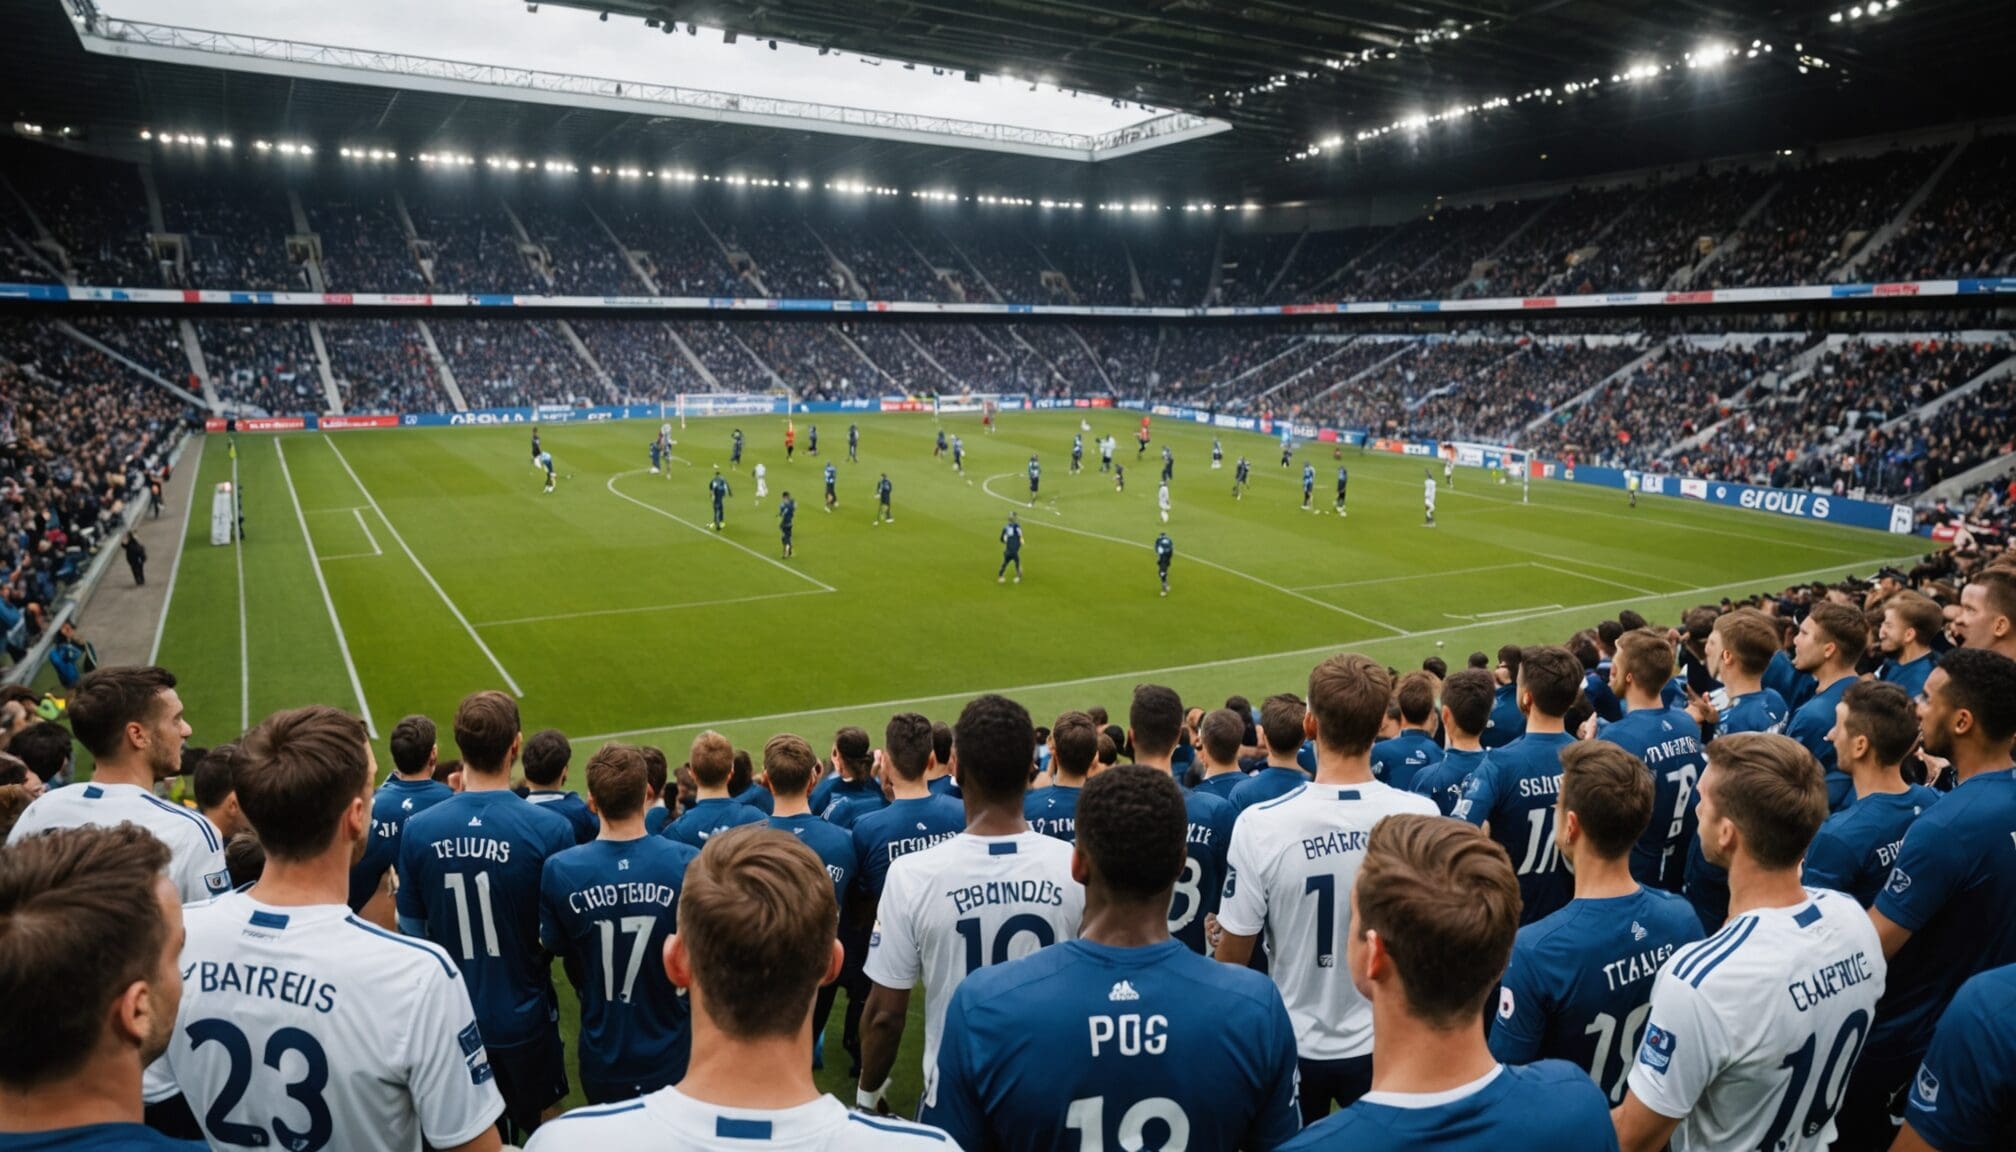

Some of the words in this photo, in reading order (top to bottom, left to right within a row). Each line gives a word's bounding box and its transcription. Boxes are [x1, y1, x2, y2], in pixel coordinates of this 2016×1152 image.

[444, 871, 500, 960] 11
[593, 915, 657, 1003] 17
[185, 1018, 333, 1152] 23
